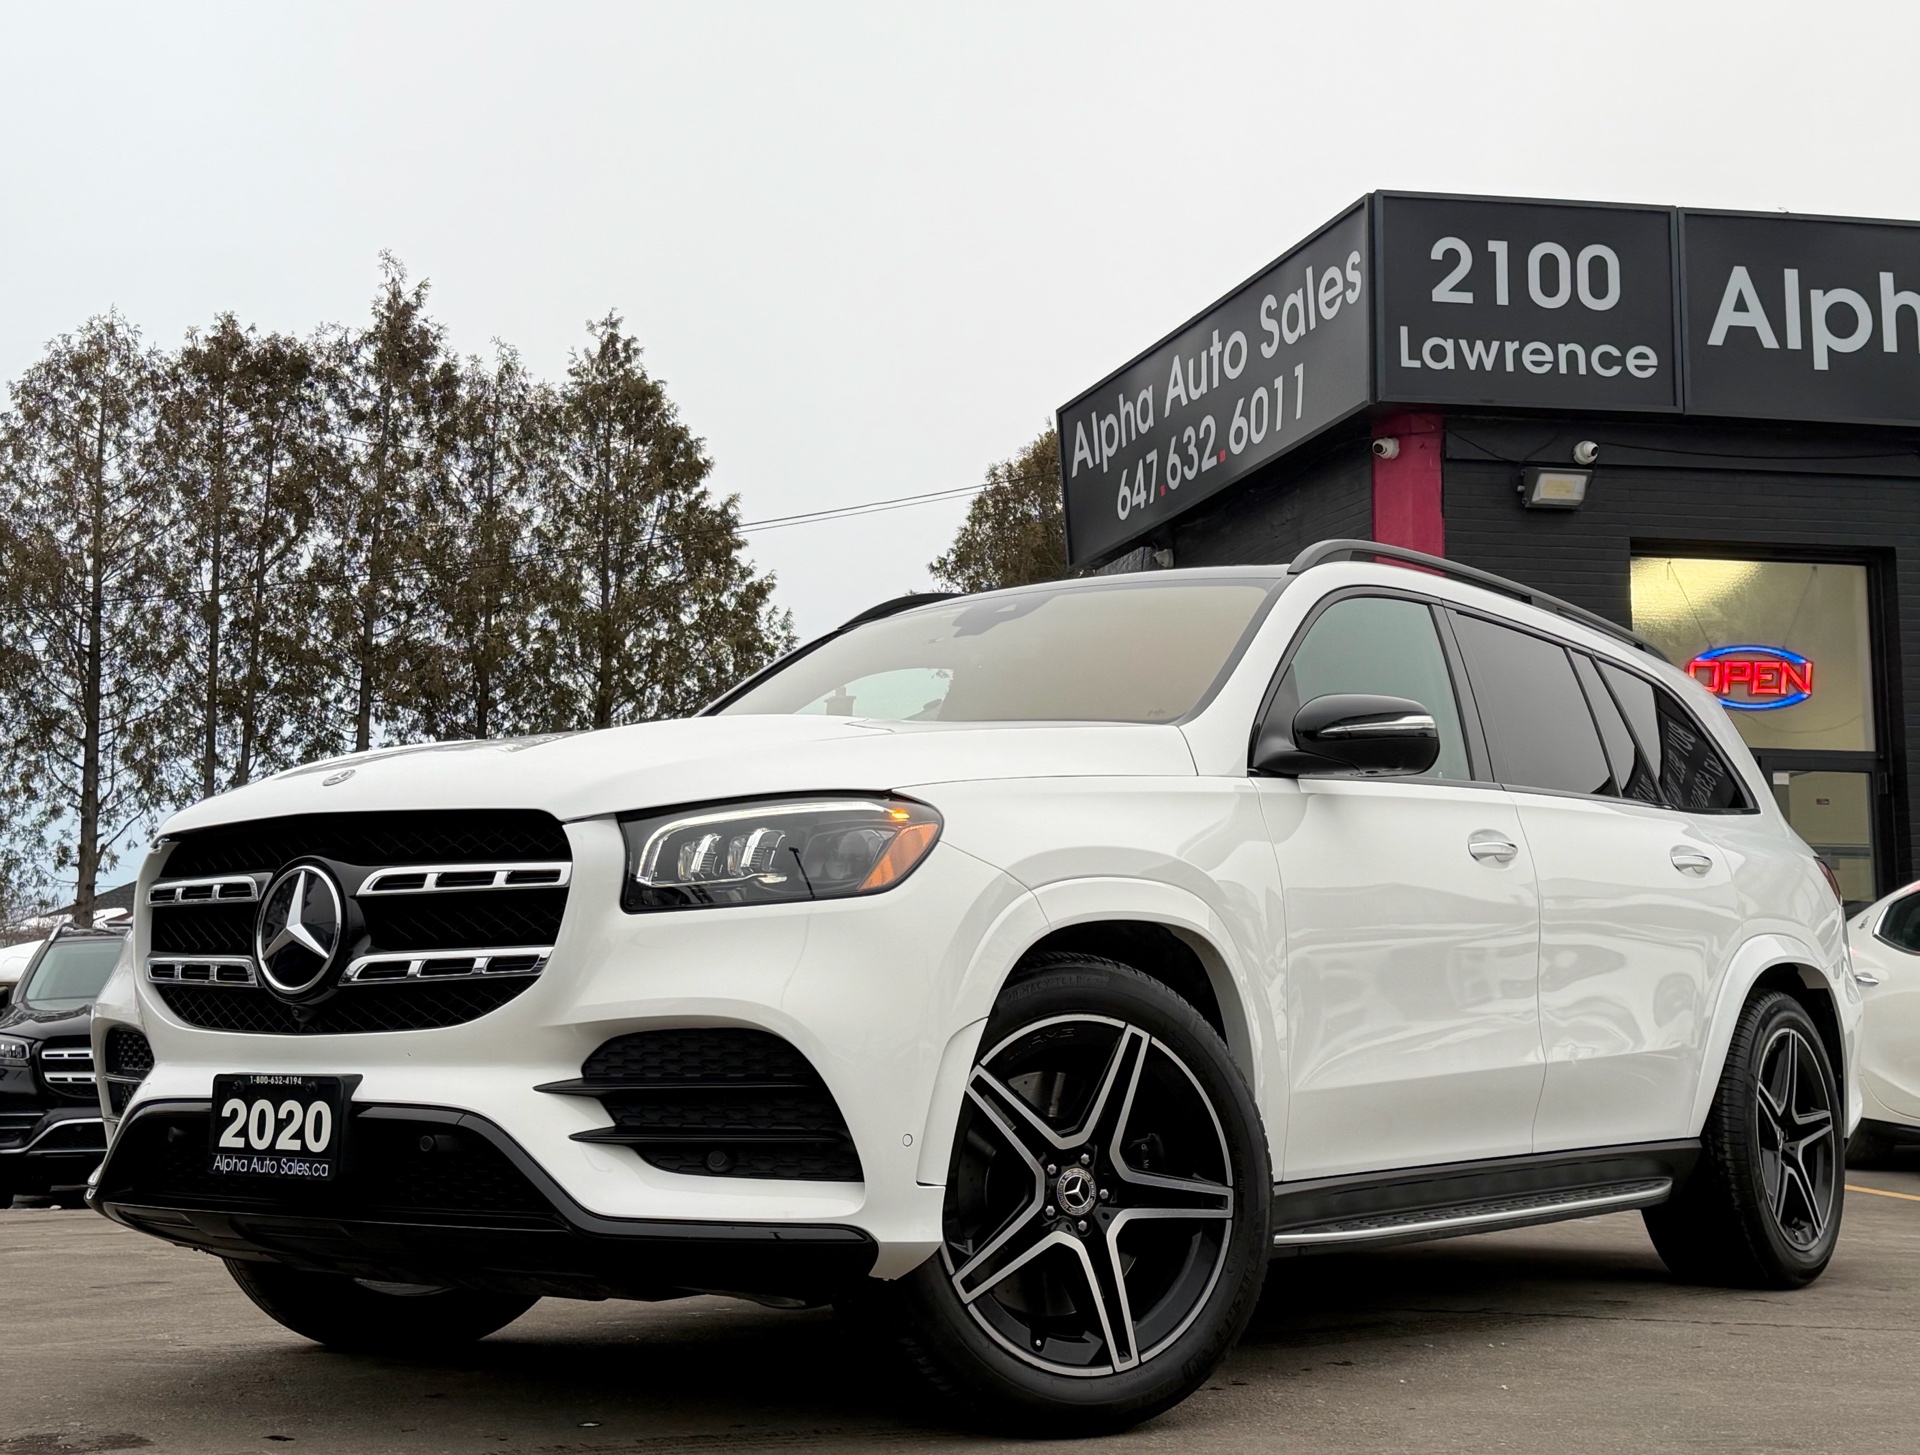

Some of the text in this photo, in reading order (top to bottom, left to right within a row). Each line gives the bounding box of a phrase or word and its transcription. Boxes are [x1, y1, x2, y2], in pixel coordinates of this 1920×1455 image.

[1431, 236, 1620, 311] 2100
[1072, 250, 1363, 478] Alpha Auto Sales
[1399, 325, 1658, 379] Lawrence
[1116, 362, 1305, 521] 647.632.6011
[1686, 659, 1814, 695] OPEN
[249, 1075, 302, 1085] 1-800-632-4194
[218, 1098, 333, 1153] 2020
[213, 1154, 329, 1178] Alpha Auto Sales.ca
